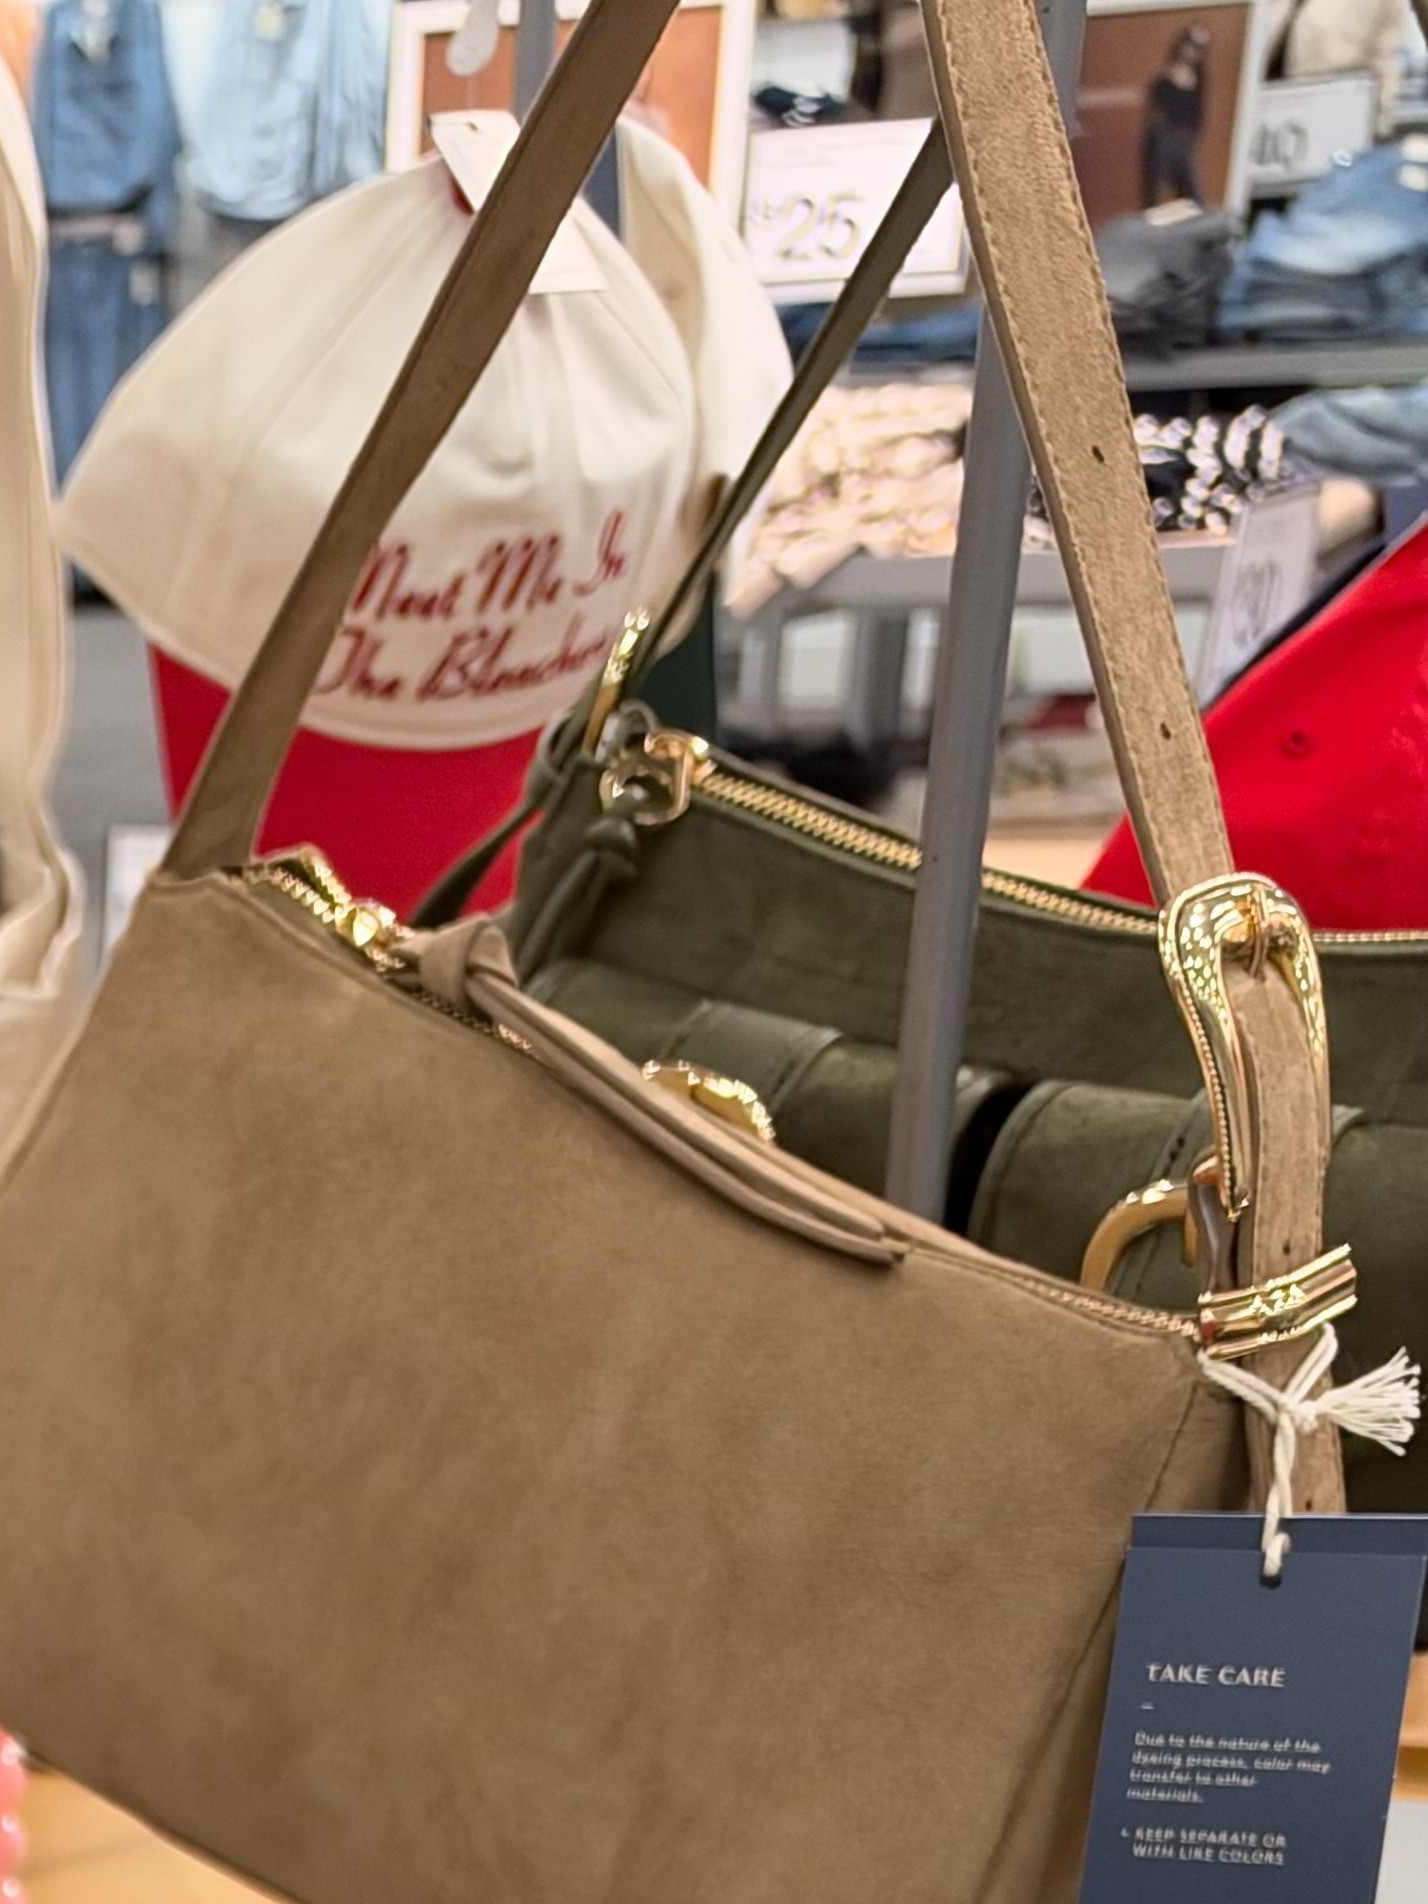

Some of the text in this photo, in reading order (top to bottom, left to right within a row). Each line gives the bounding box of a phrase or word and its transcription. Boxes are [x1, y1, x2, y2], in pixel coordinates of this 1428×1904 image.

[475, 533, 563, 614] Me
[1147, 1663, 1287, 1688] TAKE CARE
[1134, 1730, 1165, 1748] Due
[1168, 1732, 1185, 1748] to
[1189, 1733, 1214, 1750] the
[1273, 1737, 1292, 1752] of
[1294, 1738, 1322, 1754] the
[1134, 1826, 1287, 1849] KEEP SEPARATE OR
[1132, 1842, 1285, 1867] WITH LIKE COLORS
